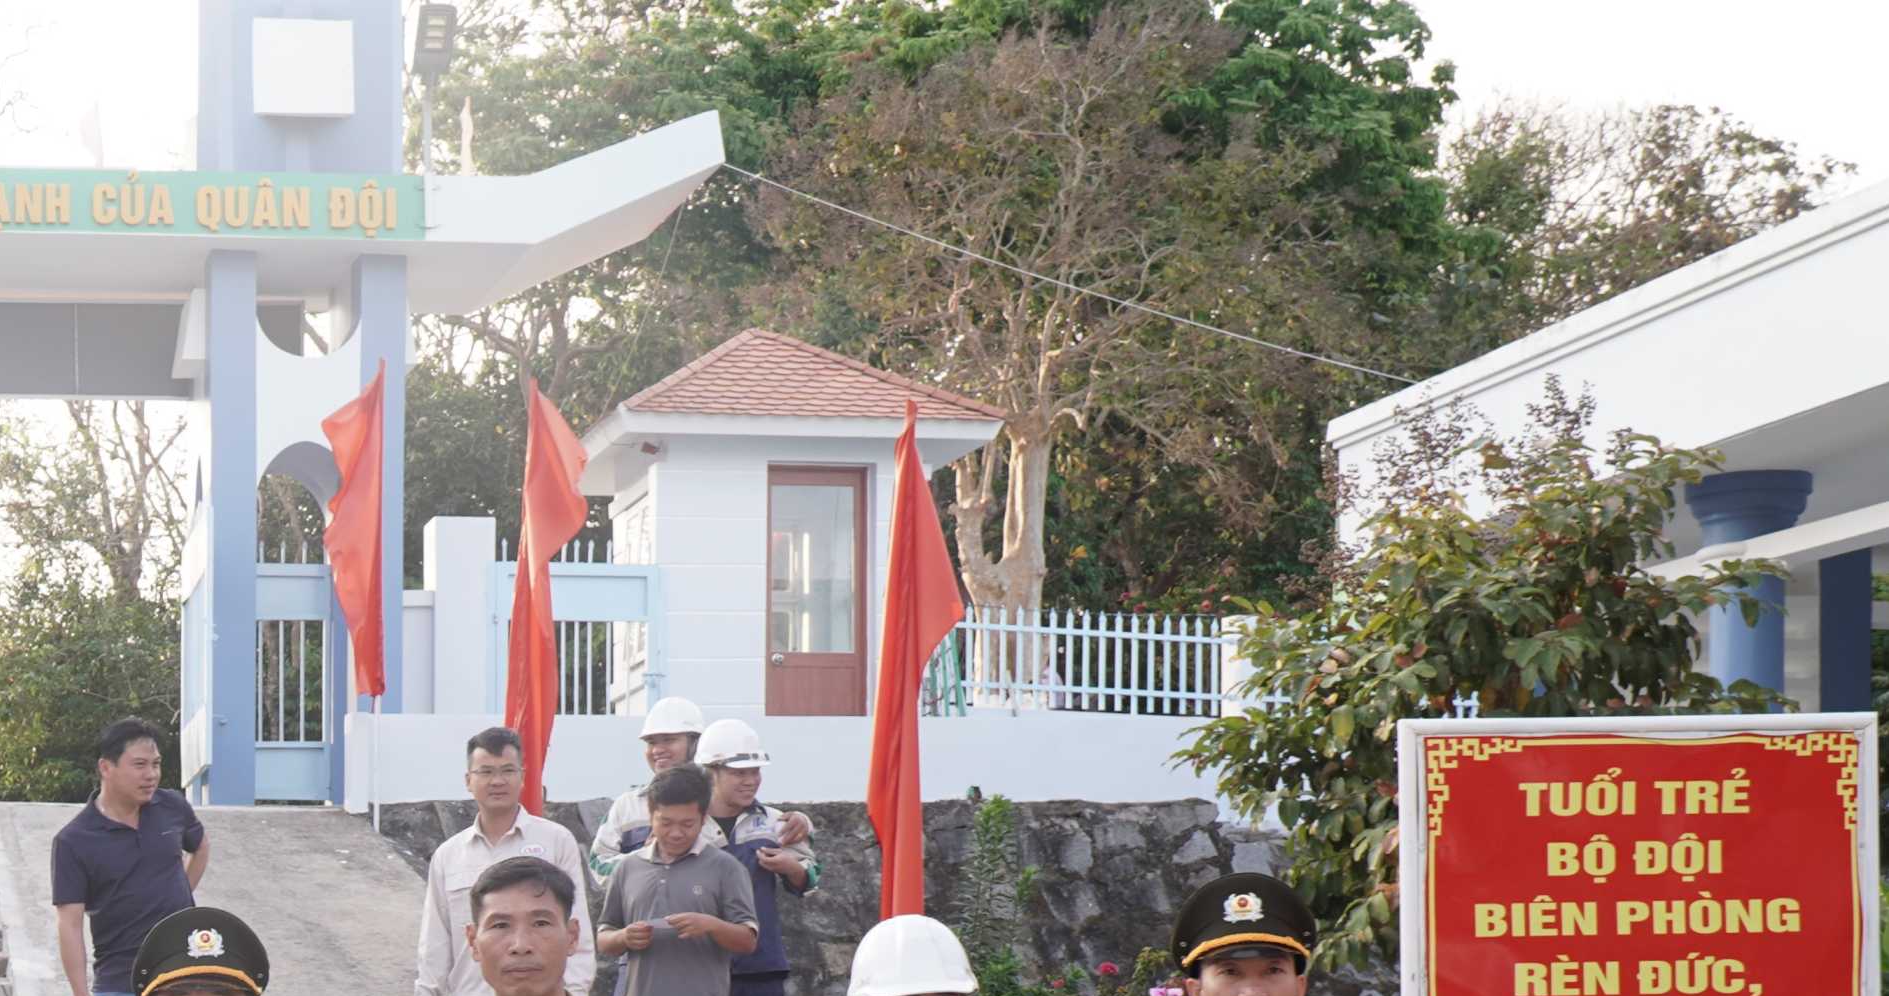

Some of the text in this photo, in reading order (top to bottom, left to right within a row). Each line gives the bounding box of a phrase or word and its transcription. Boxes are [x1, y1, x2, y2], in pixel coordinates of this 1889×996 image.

[92, 168, 175, 226] CỦA
[196, 176, 309, 231] QUÂN
[328, 178, 399, 238] ĐỘI
[1519, 768, 1750, 816] TUỔI TRẺ
[1548, 833, 1721, 883] BỘ ĐỘI
[1475, 892, 1800, 937] BIÊN PHÒNG
[1515, 953, 1761, 996] RÈN ĐỨC,
